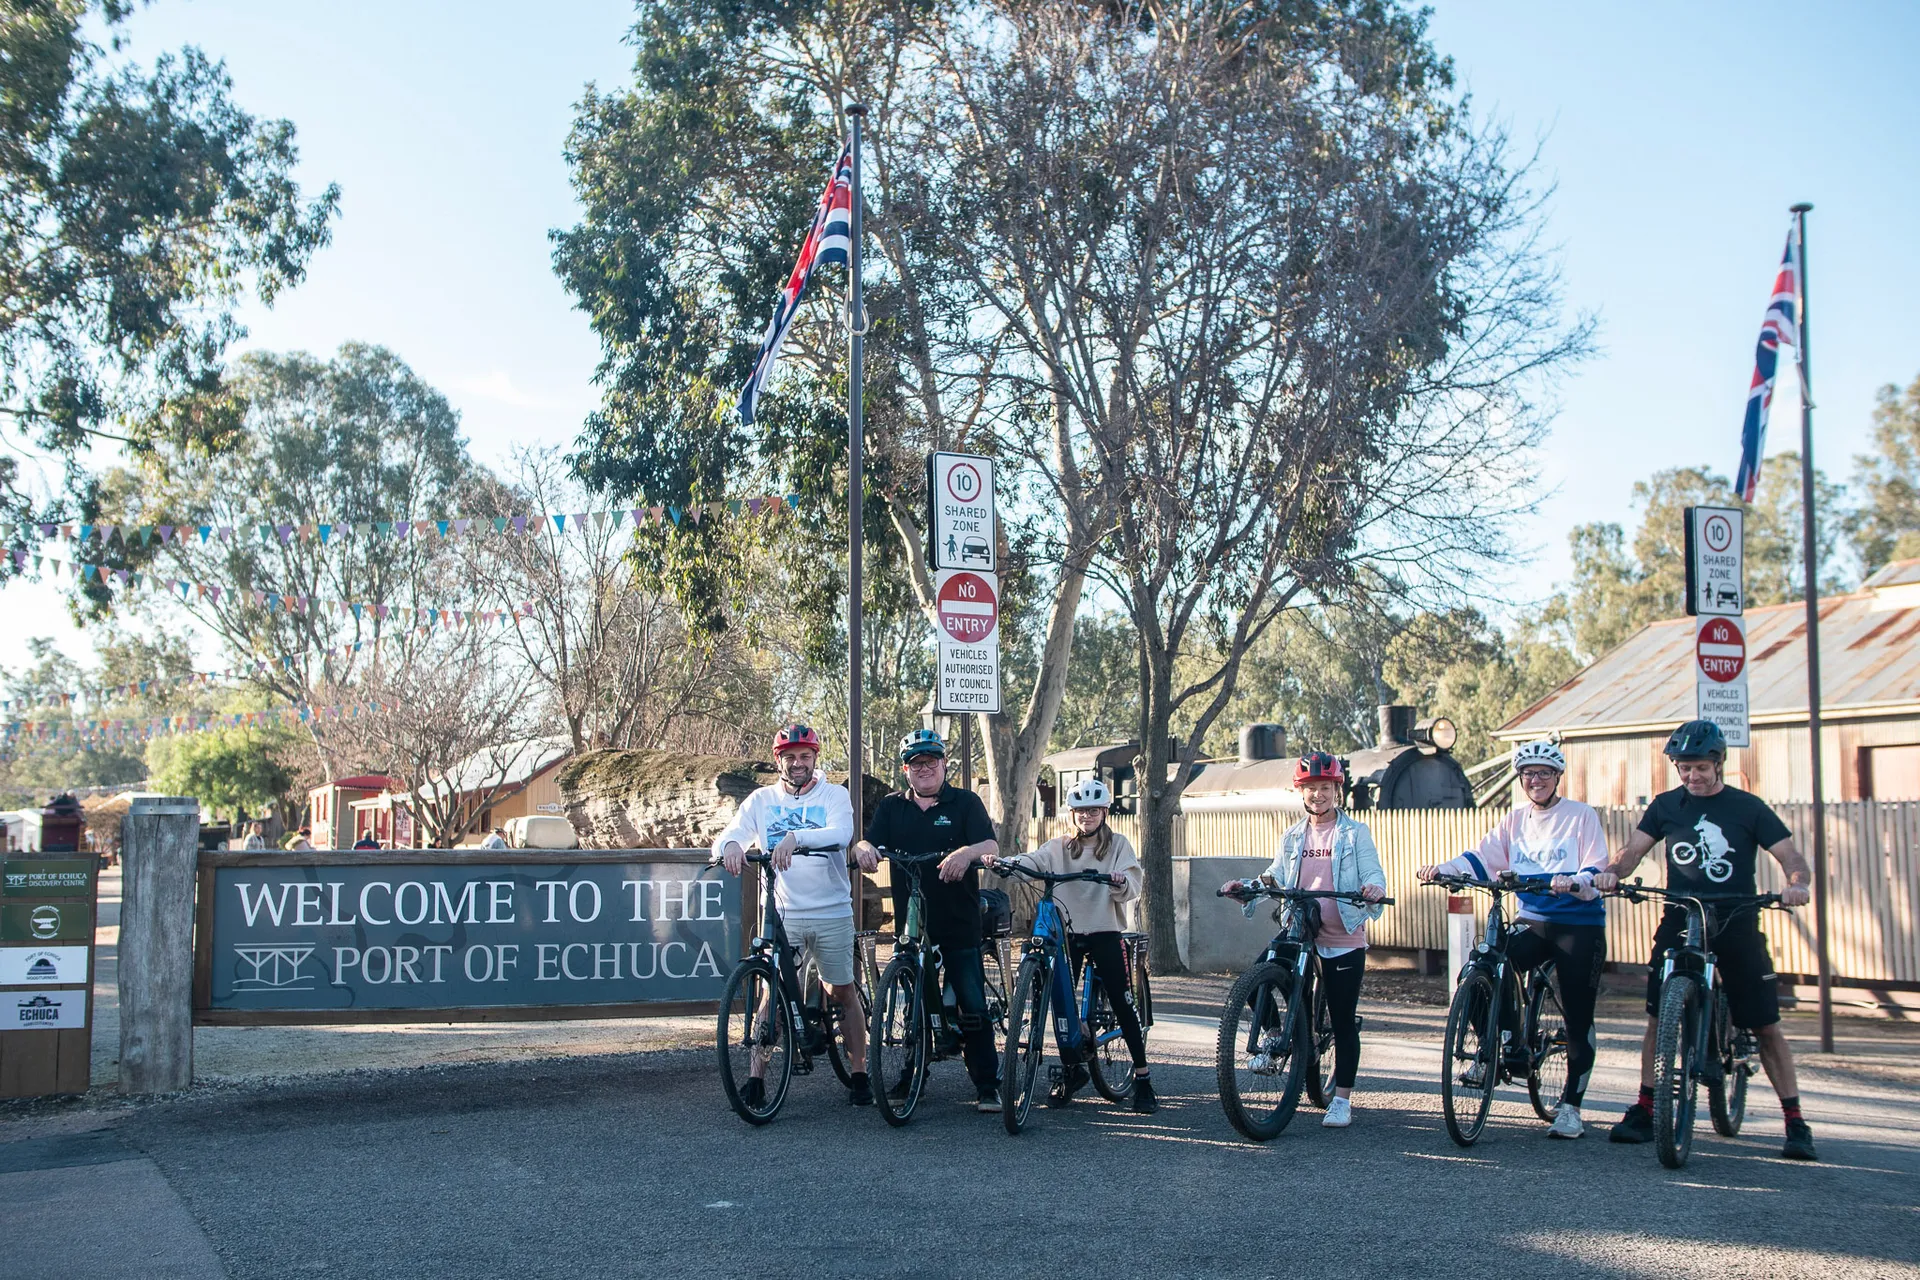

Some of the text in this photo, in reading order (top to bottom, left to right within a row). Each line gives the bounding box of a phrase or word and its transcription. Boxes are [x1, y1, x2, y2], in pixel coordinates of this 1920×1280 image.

[957, 474, 972, 492] 10
[945, 505, 987, 519] SHARED
[952, 519, 980, 532] ZONE
[1712, 525, 1724, 541] 10
[1703, 554, 1737, 567] SHARED
[1709, 568, 1731, 579] ZONE
[958, 583, 977, 598] NO
[946, 617, 989, 633] ENTRY
[1713, 627, 1729, 642] NO
[950, 648, 988, 661] VEHICLES
[945, 664, 993, 675] AUTHORISED
[1703, 658, 1739, 674] ENTRY
[945, 678, 993, 690] BY COUNCIL
[950, 692, 989, 704] EXCEPTED
[1707, 689, 1739, 699] VEHICLES
[1702, 702, 1744, 713] AUTHORISED
[1715, 716, 1744, 726] COUNCIL
[1724, 730, 1741, 740] PTED
[1302, 849, 1332, 858] OSSIM
[59, 872, 87, 880] ECHUCA
[234, 879, 725, 927] WELCOME TO THE
[331, 941, 724, 985] PORT OF ECHUCA
[20, 1008, 59, 1021] ECHUCA
